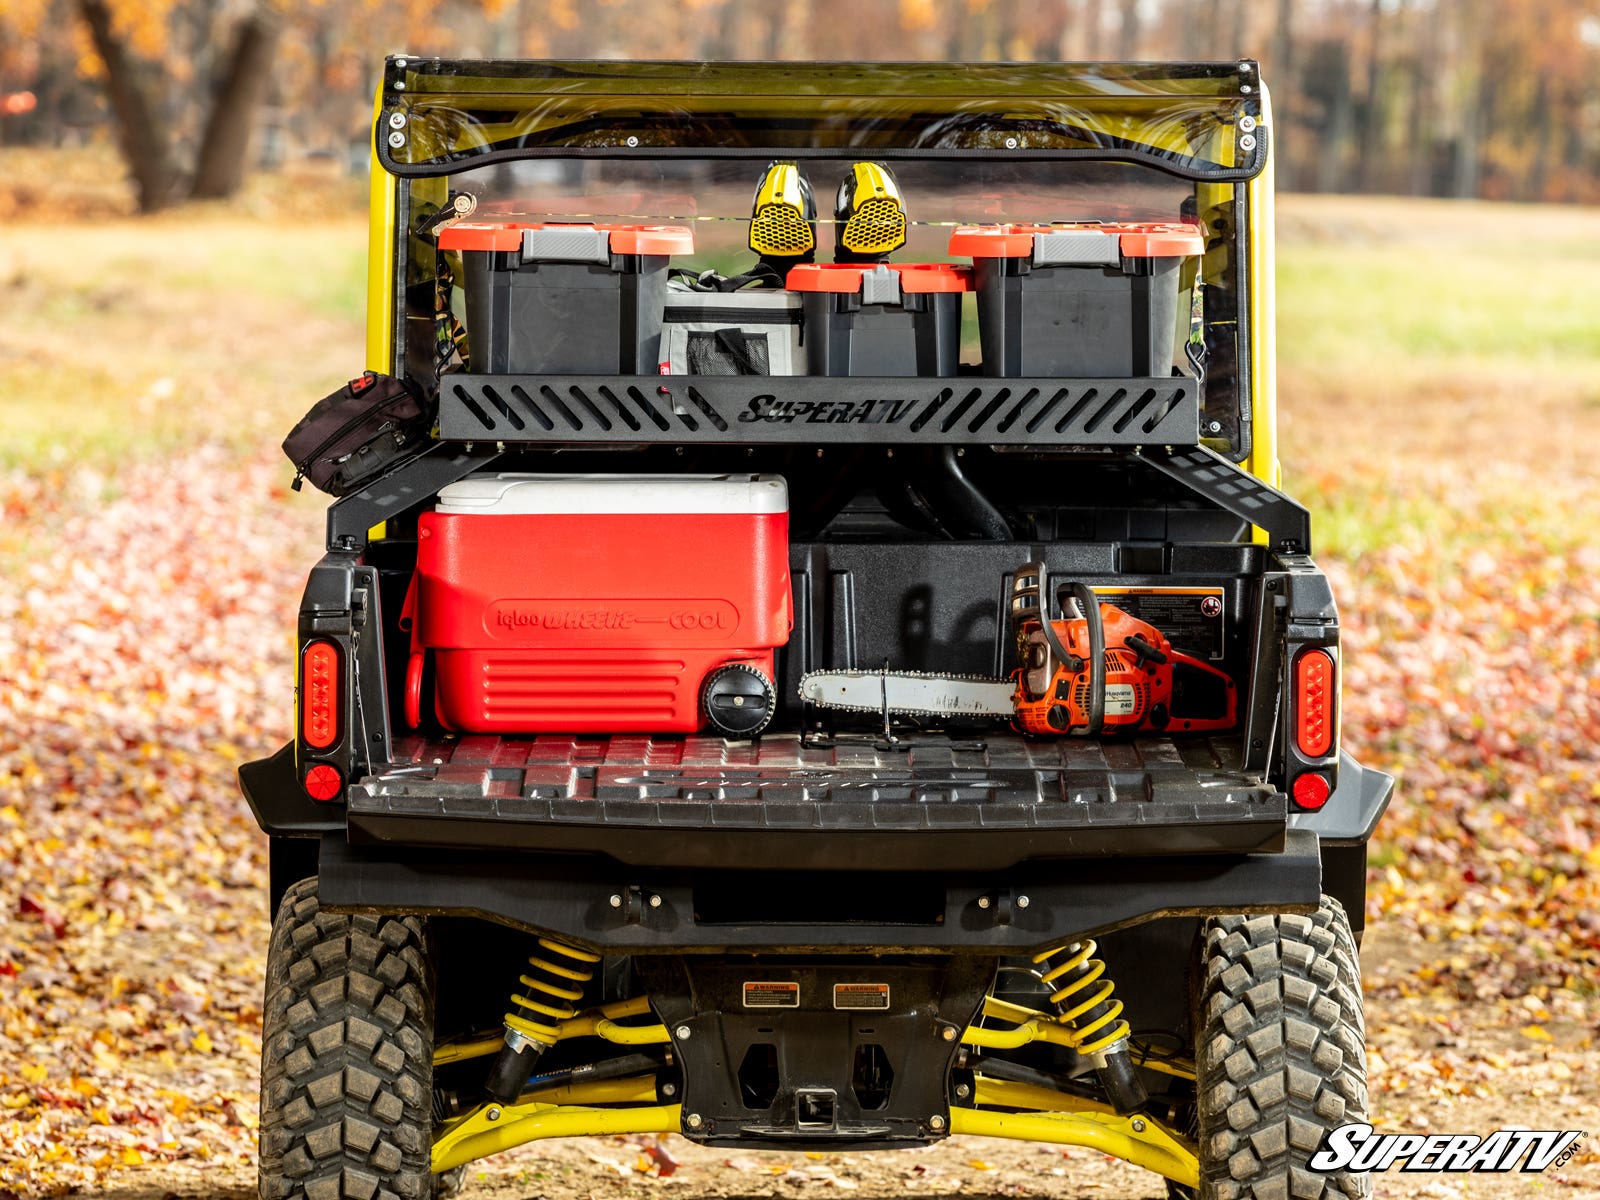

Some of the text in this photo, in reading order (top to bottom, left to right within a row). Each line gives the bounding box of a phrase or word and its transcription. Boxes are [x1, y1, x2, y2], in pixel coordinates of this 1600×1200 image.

[738, 394, 919, 424] SUPERATV
[497, 609, 539, 631] igloo
[668, 611, 728, 630] COOL
